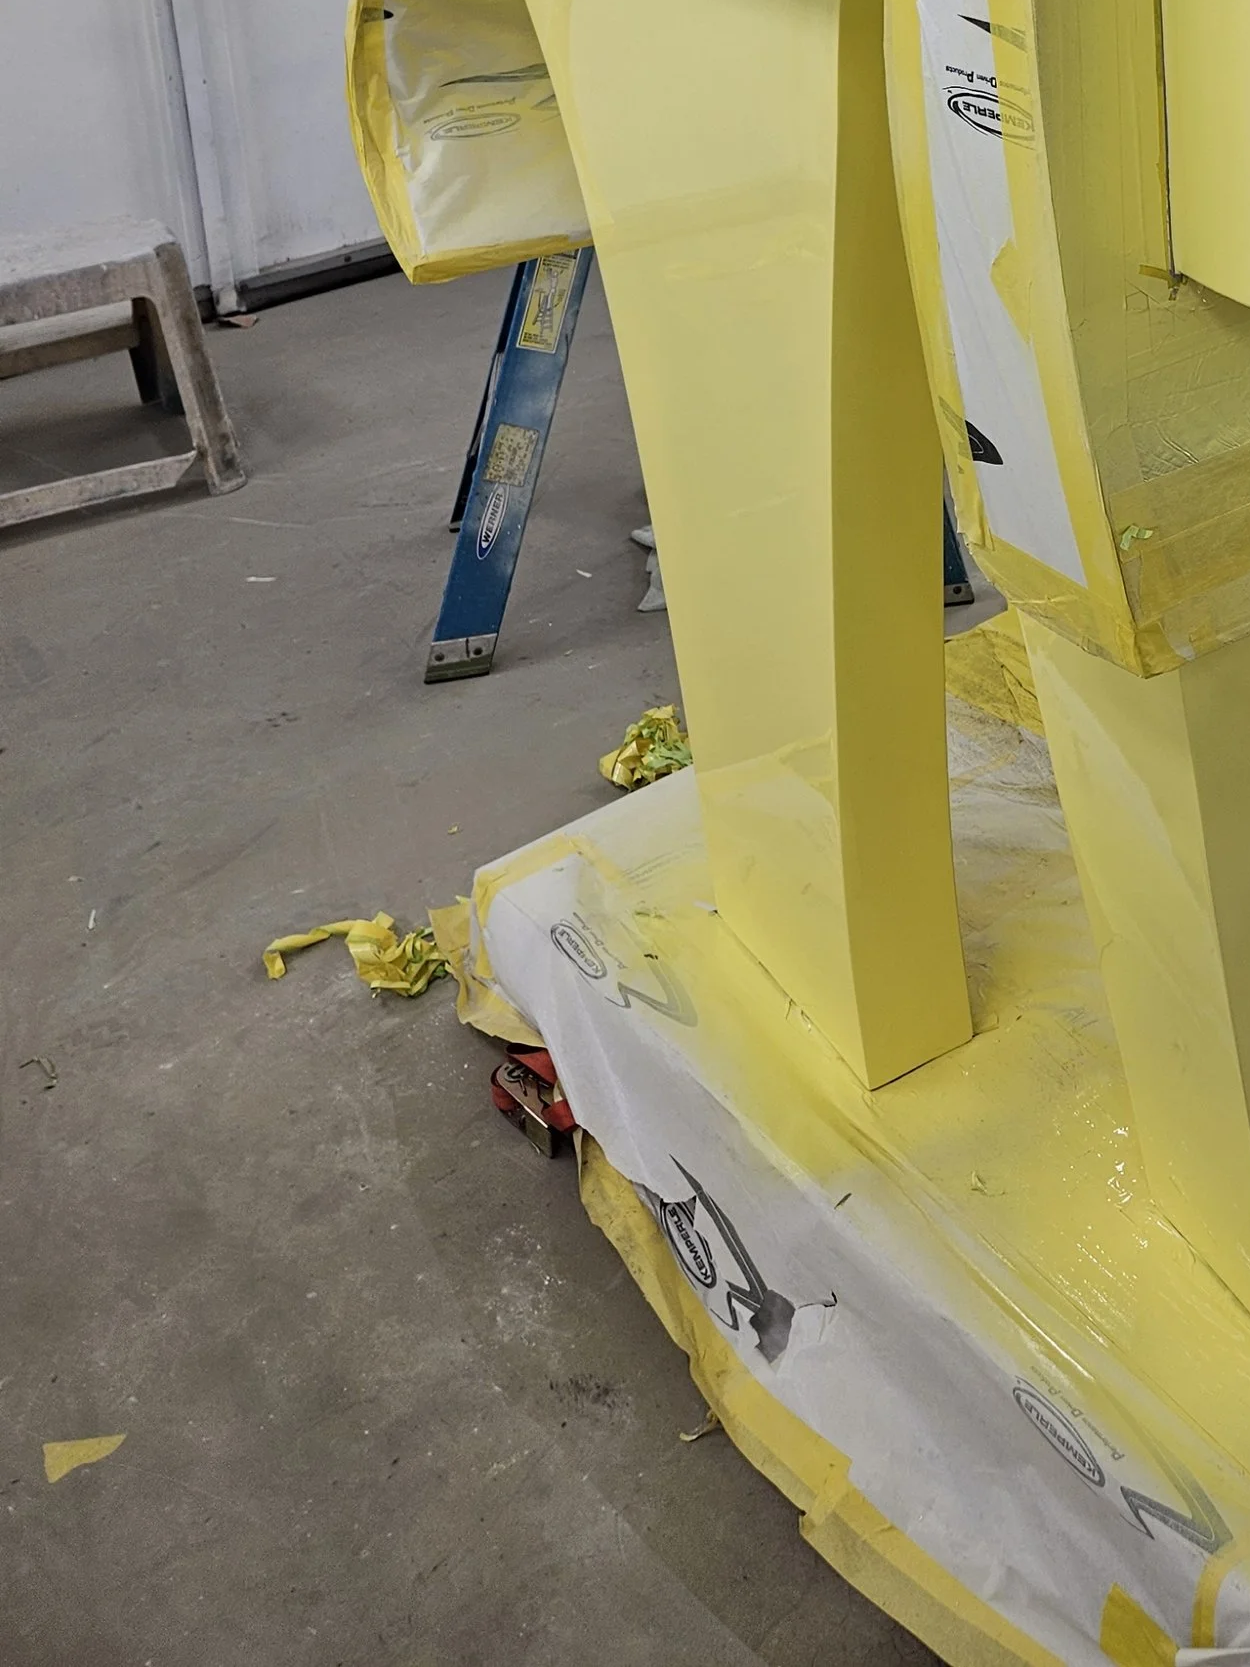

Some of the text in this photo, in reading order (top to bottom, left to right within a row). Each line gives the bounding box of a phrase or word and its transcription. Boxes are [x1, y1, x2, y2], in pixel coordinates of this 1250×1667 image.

[961, 100, 1035, 133] KEMPERLE
[481, 493, 503, 543] WERNER
[558, 928, 602, 974] KEMPERLE
[667, 1206, 711, 1281] KEMPERLE
[1024, 1398, 1096, 1477] KEMPERLE
